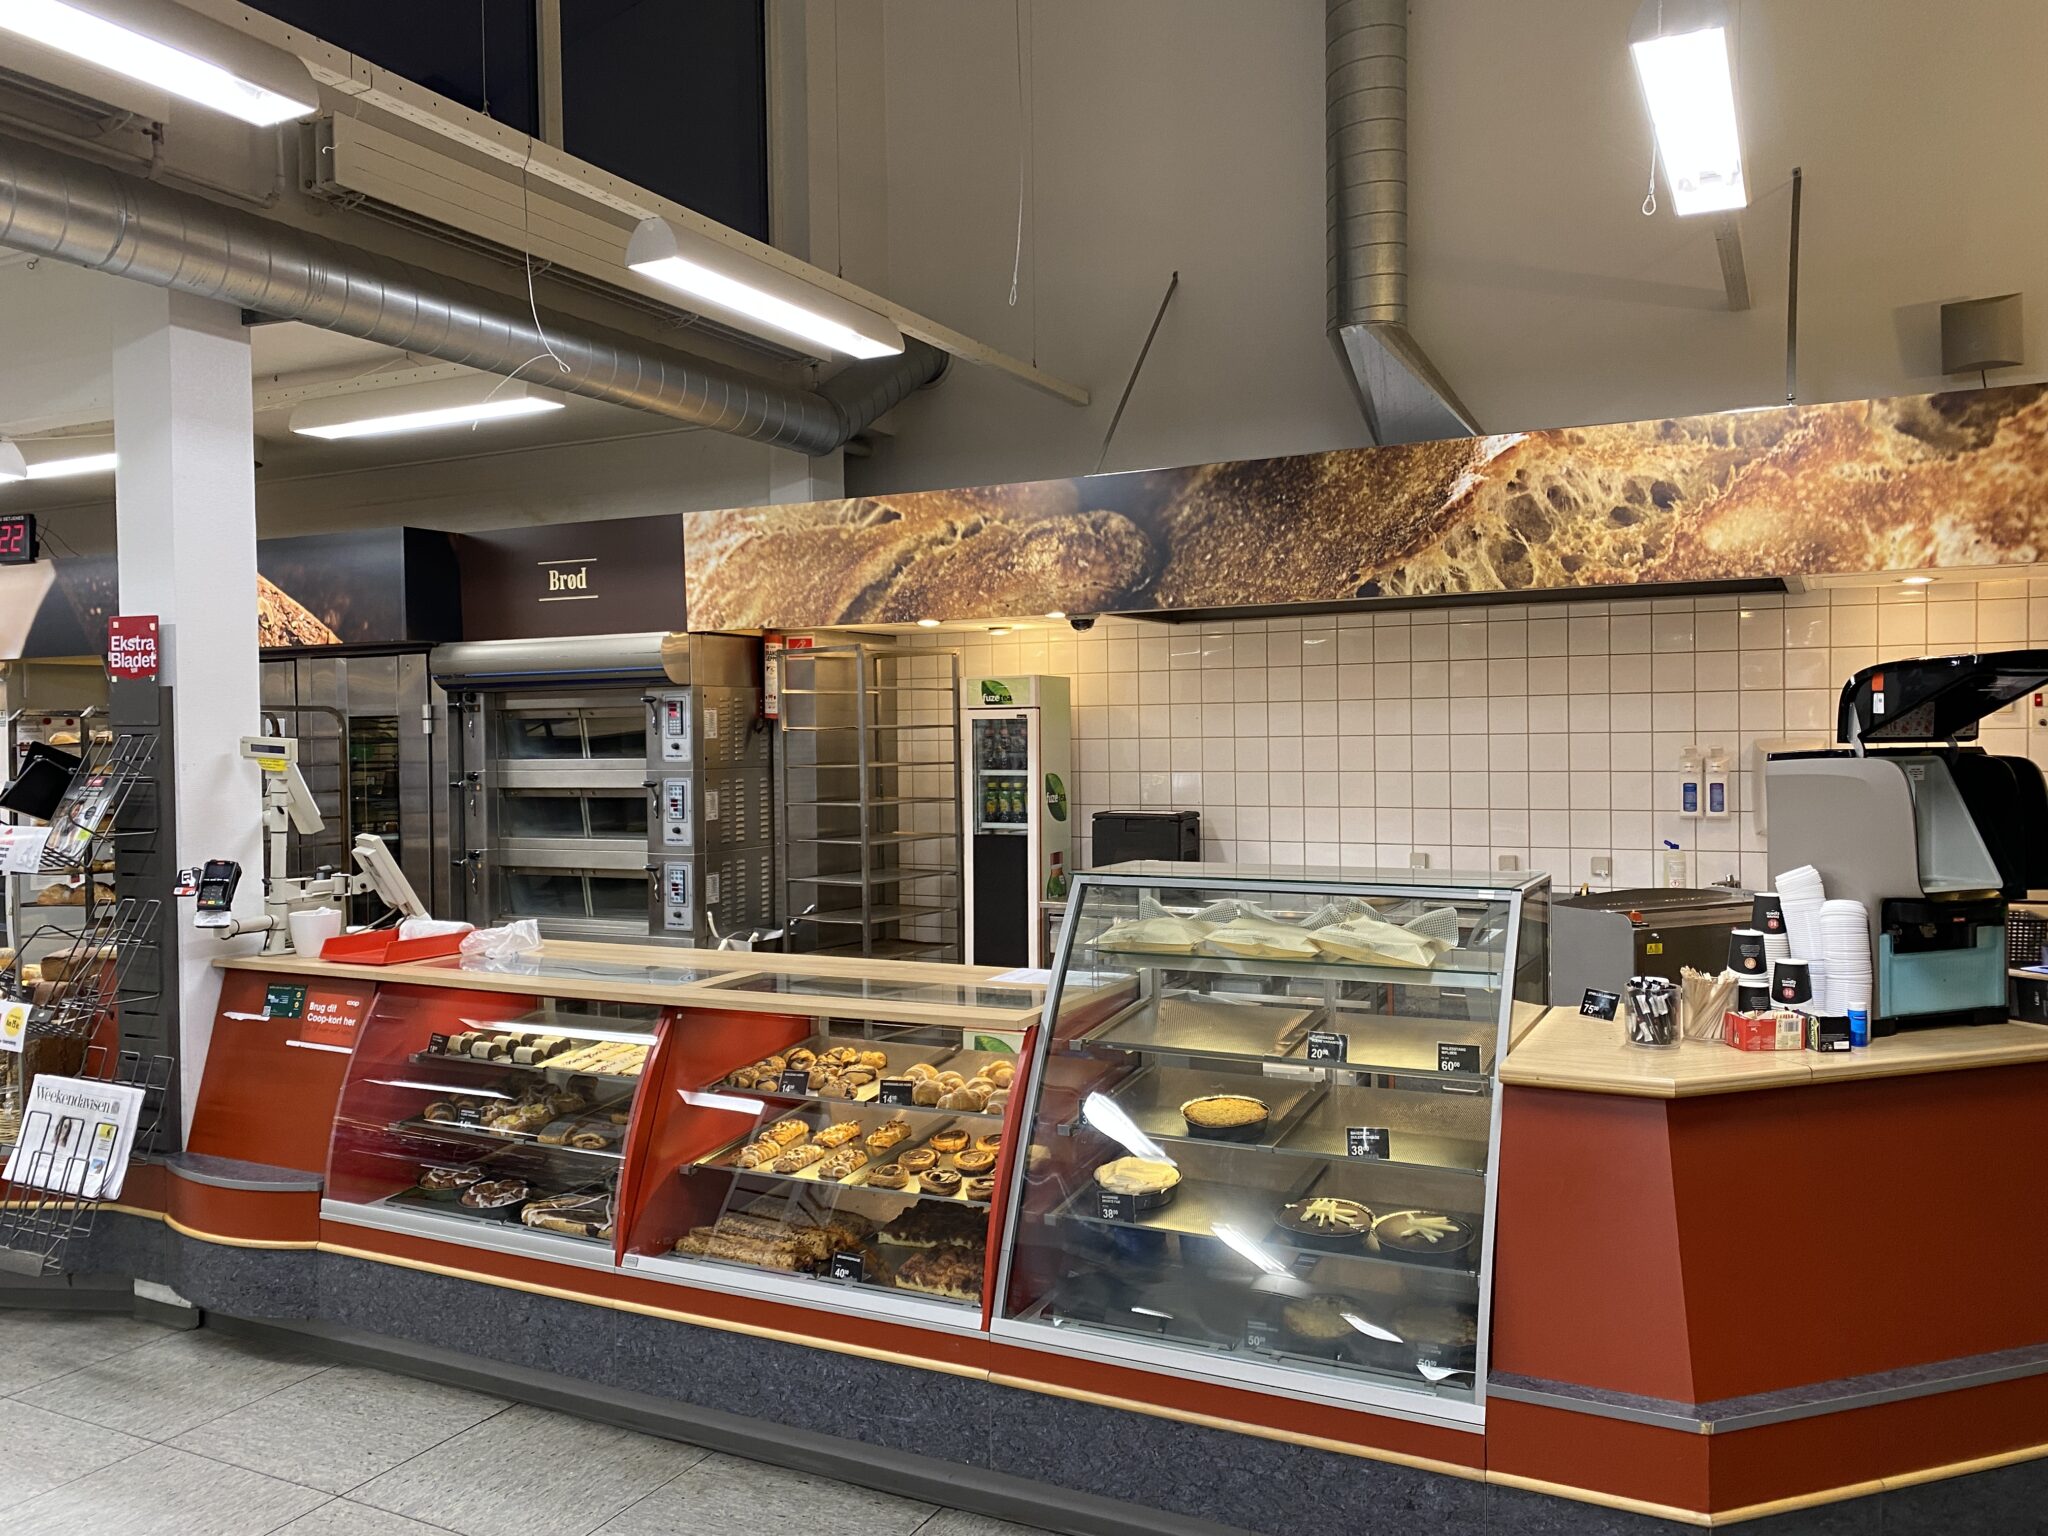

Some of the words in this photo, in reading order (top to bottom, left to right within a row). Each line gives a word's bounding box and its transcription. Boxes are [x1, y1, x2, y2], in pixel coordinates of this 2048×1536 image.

[549, 567, 587, 590] Brød
[111, 635, 156, 651] Ekstra
[111, 651, 156, 668] Bladet
[309, 1002, 326, 1013] Brug
[327, 1004, 337, 1012] dit
[307, 1013, 343, 1024] Coop-kort
[343, 1016, 356, 1026] her
[36, 1086, 110, 1113] Weekendavisen
